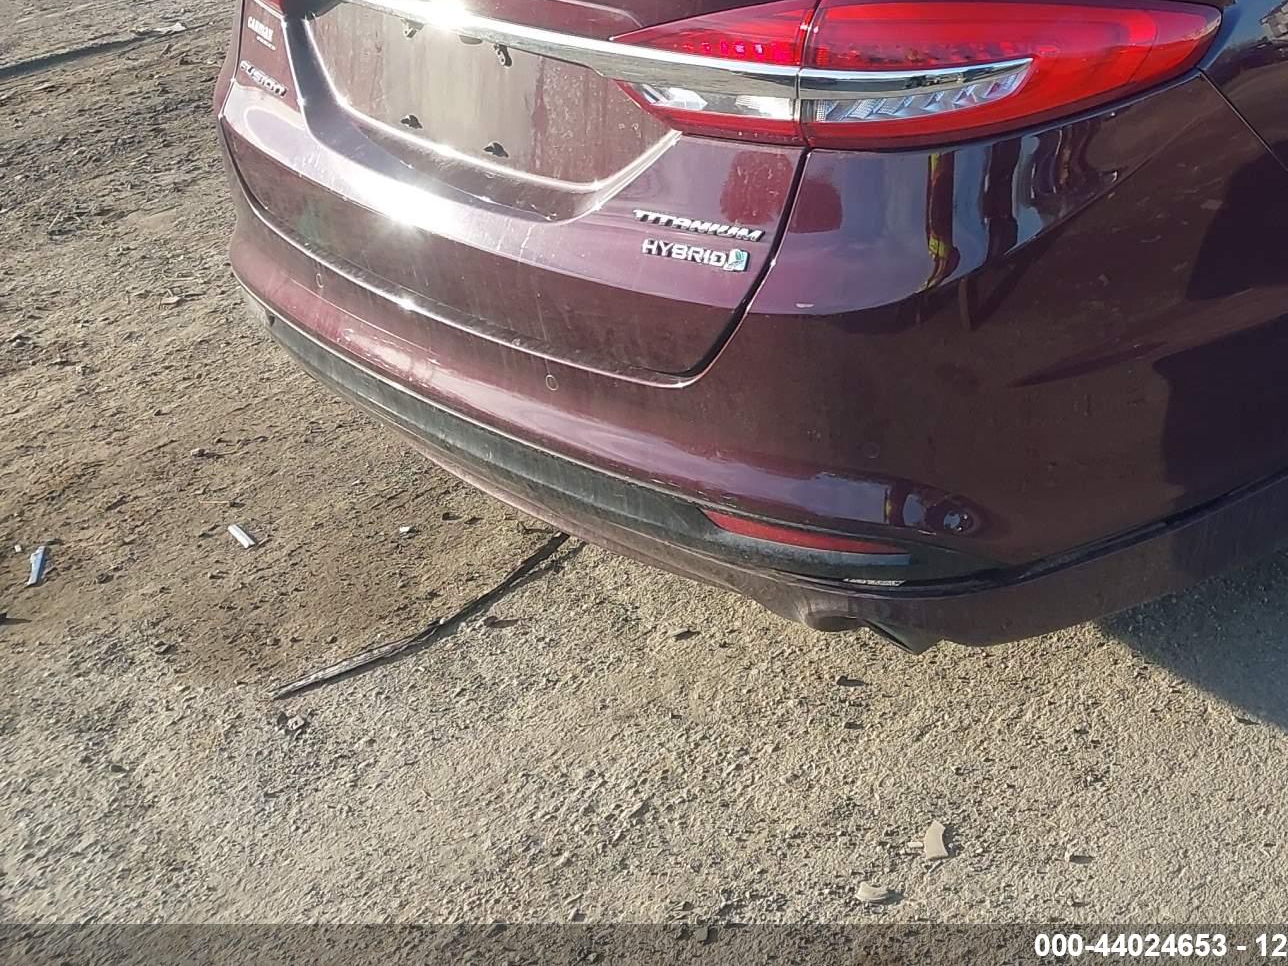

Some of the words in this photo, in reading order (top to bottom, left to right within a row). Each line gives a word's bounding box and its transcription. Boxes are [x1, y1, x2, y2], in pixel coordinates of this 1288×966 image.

[240, 60, 287, 98] FUSION
[632, 209, 764, 242] TITANIUM
[642, 239, 727, 267] HYBRID
